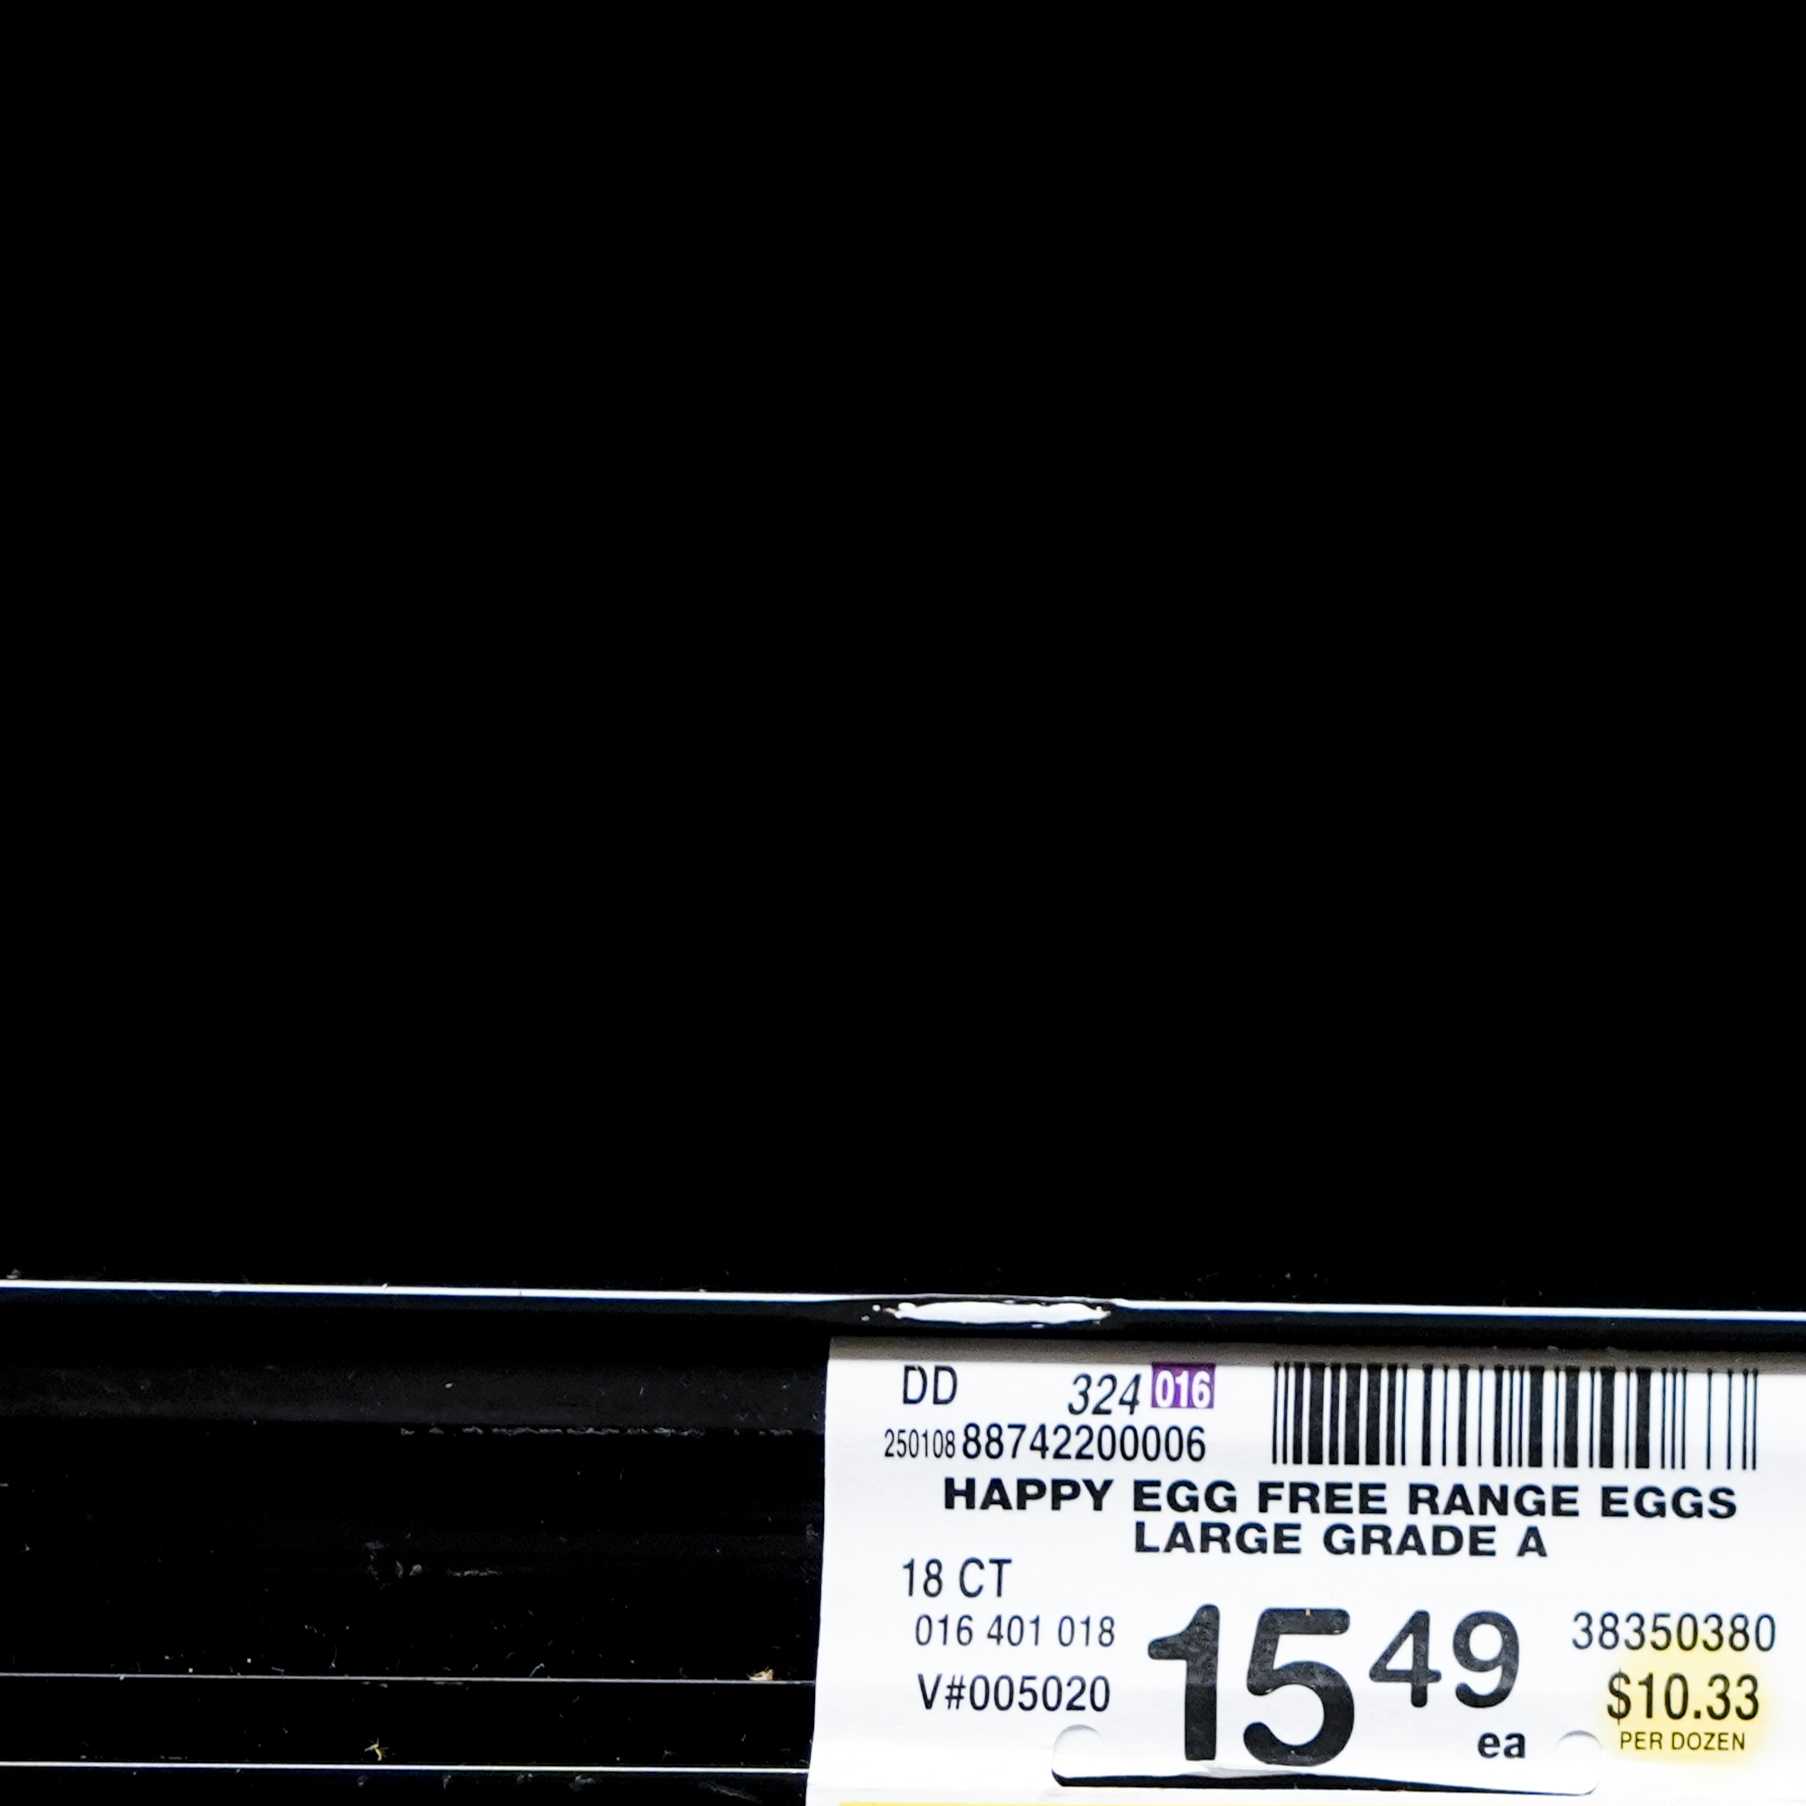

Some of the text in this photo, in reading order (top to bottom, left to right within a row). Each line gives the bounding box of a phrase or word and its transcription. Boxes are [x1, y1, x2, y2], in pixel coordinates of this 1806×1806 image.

[902, 1364, 958, 1405] DD
[1068, 1370, 1211, 1416] 324 016
[884, 1423, 1206, 1463] 250108 88742200006
[944, 1477, 1737, 1520] HAPPY EGG FREE RANGE EGGS
[1135, 1520, 1548, 1558] LARGE GRADE A
[903, 1557, 1013, 1598] 18 CT
[915, 1614, 1115, 1648] 016 401 018
[1572, 1611, 1776, 1652] 38350380
[917, 1674, 1111, 1713] V#005020
[1607, 1667, 1759, 1725] $10.33
[1477, 1732, 1526, 1759] ea
[1620, 1731, 1745, 1751] PER DOZEN
